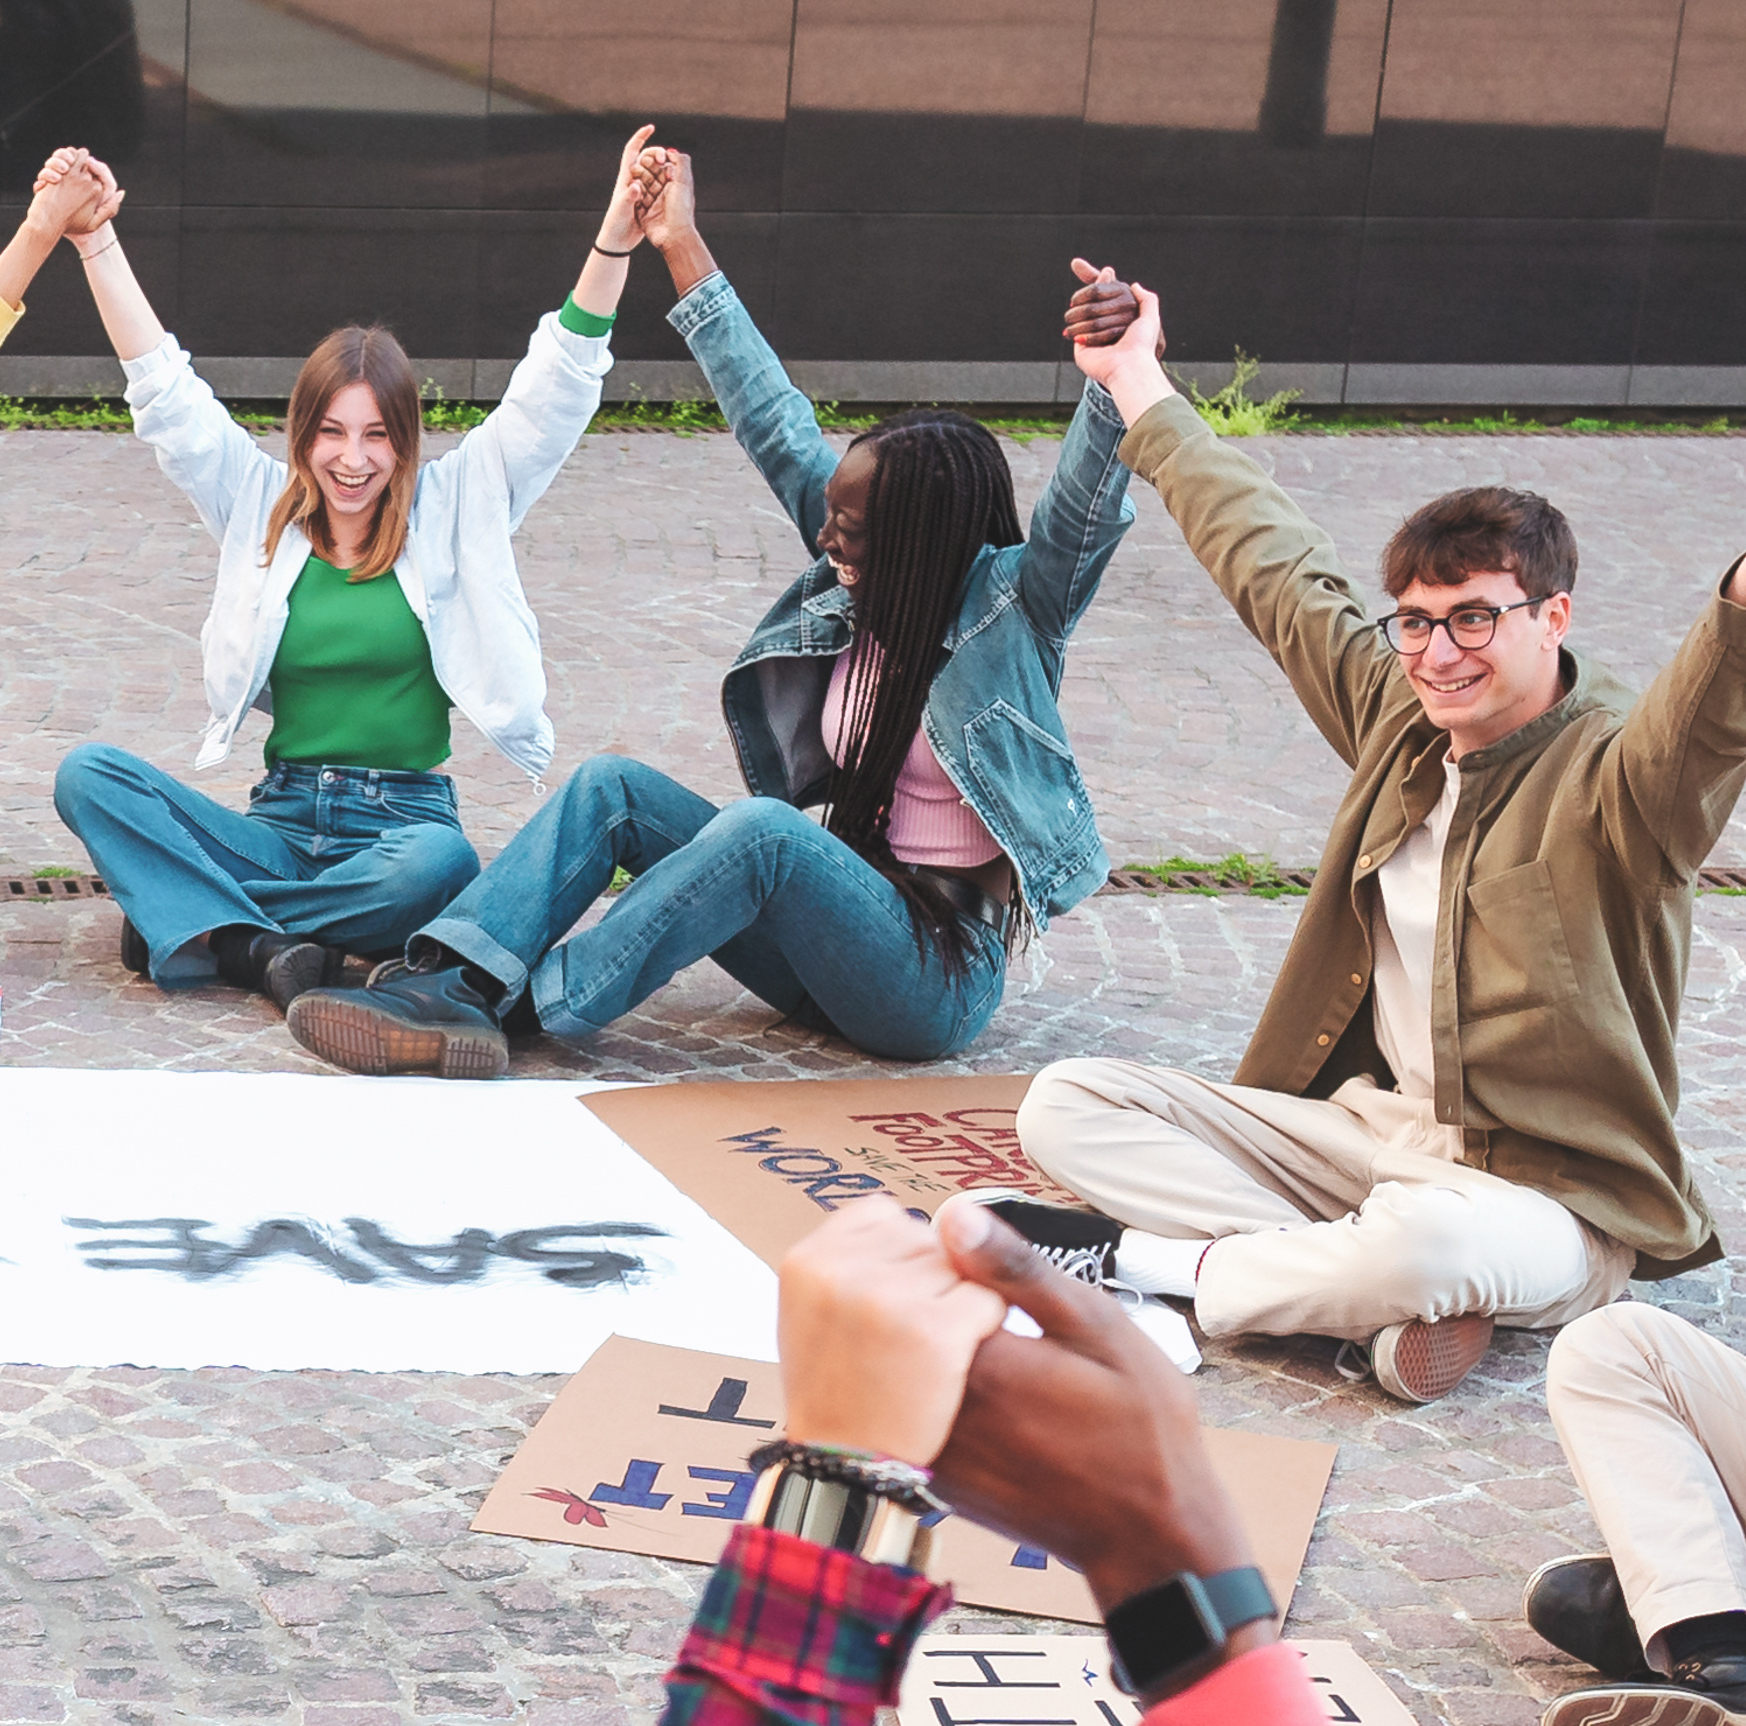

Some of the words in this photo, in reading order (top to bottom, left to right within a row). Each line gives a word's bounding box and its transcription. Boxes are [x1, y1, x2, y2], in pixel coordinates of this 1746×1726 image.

[716, 1126, 932, 1223] WORL
[843, 1147, 915, 1173] SAVE
[892, 1173, 952, 1193] THE
[61, 1215, 672, 1290] SAVE
